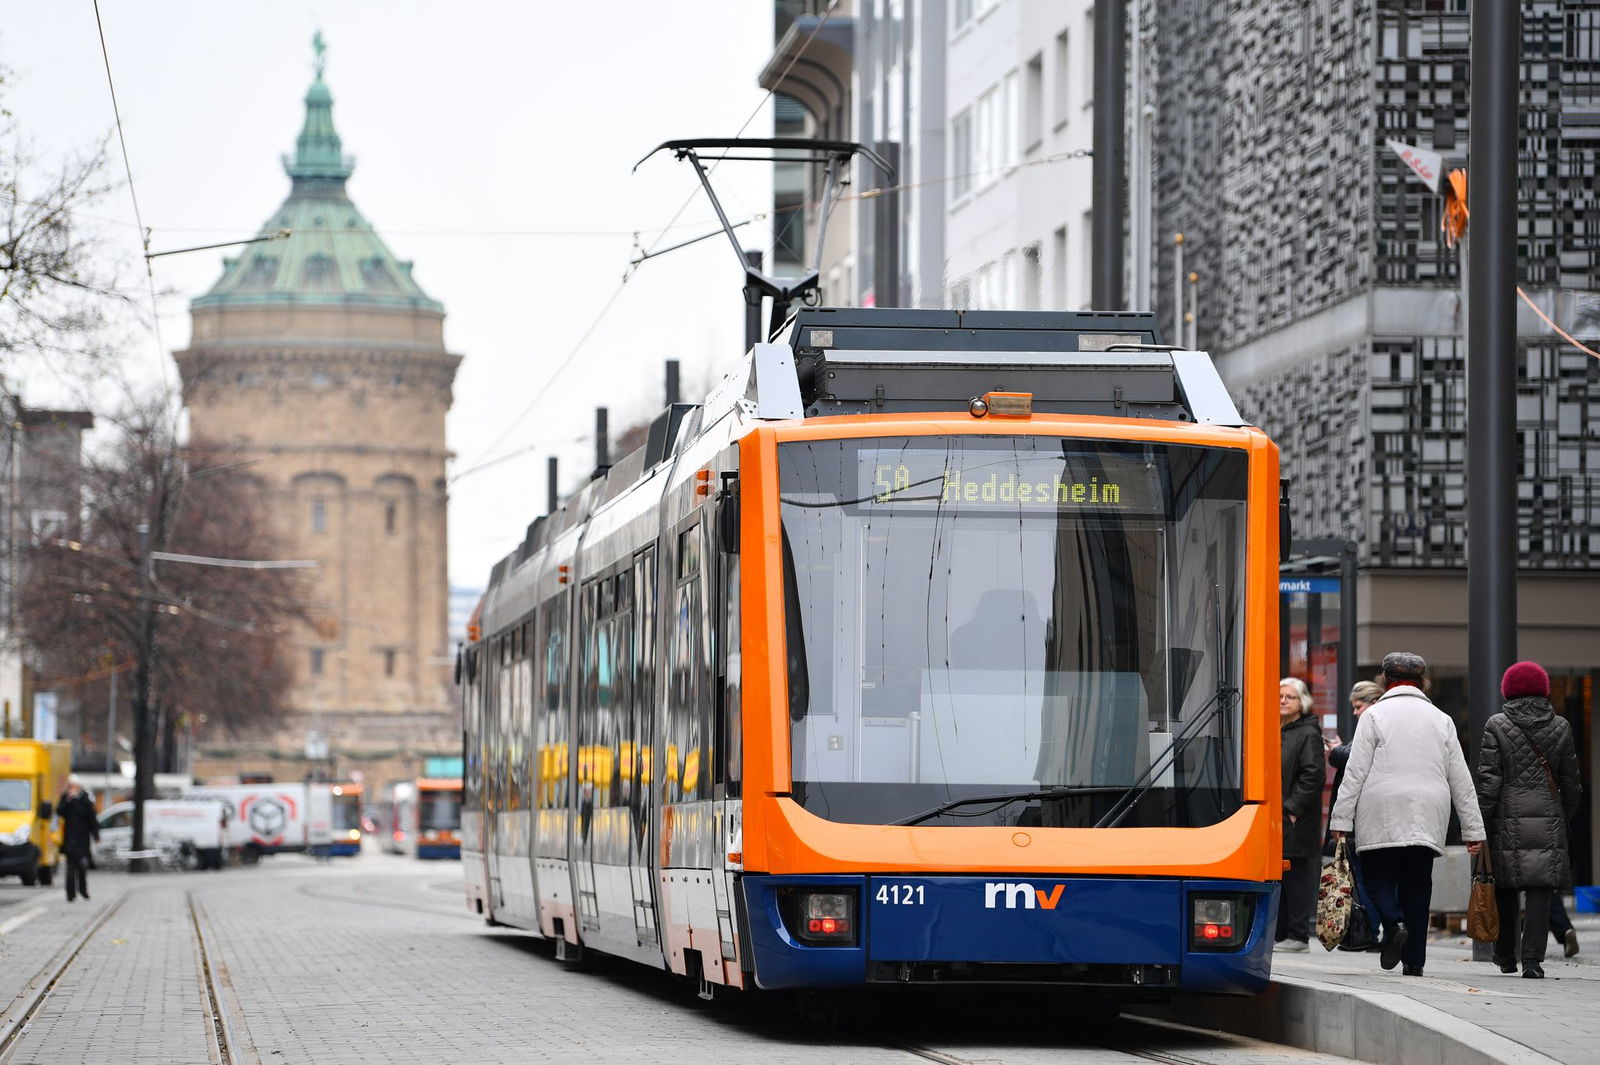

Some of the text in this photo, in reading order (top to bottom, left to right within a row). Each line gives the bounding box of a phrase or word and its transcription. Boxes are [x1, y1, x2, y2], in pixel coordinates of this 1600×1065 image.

[876, 464, 1120, 503] 5A Heddesheim
[1279, 580, 1310, 592] markt
[875, 884, 925, 905] 4121
[984, 882, 1066, 910] rnv
